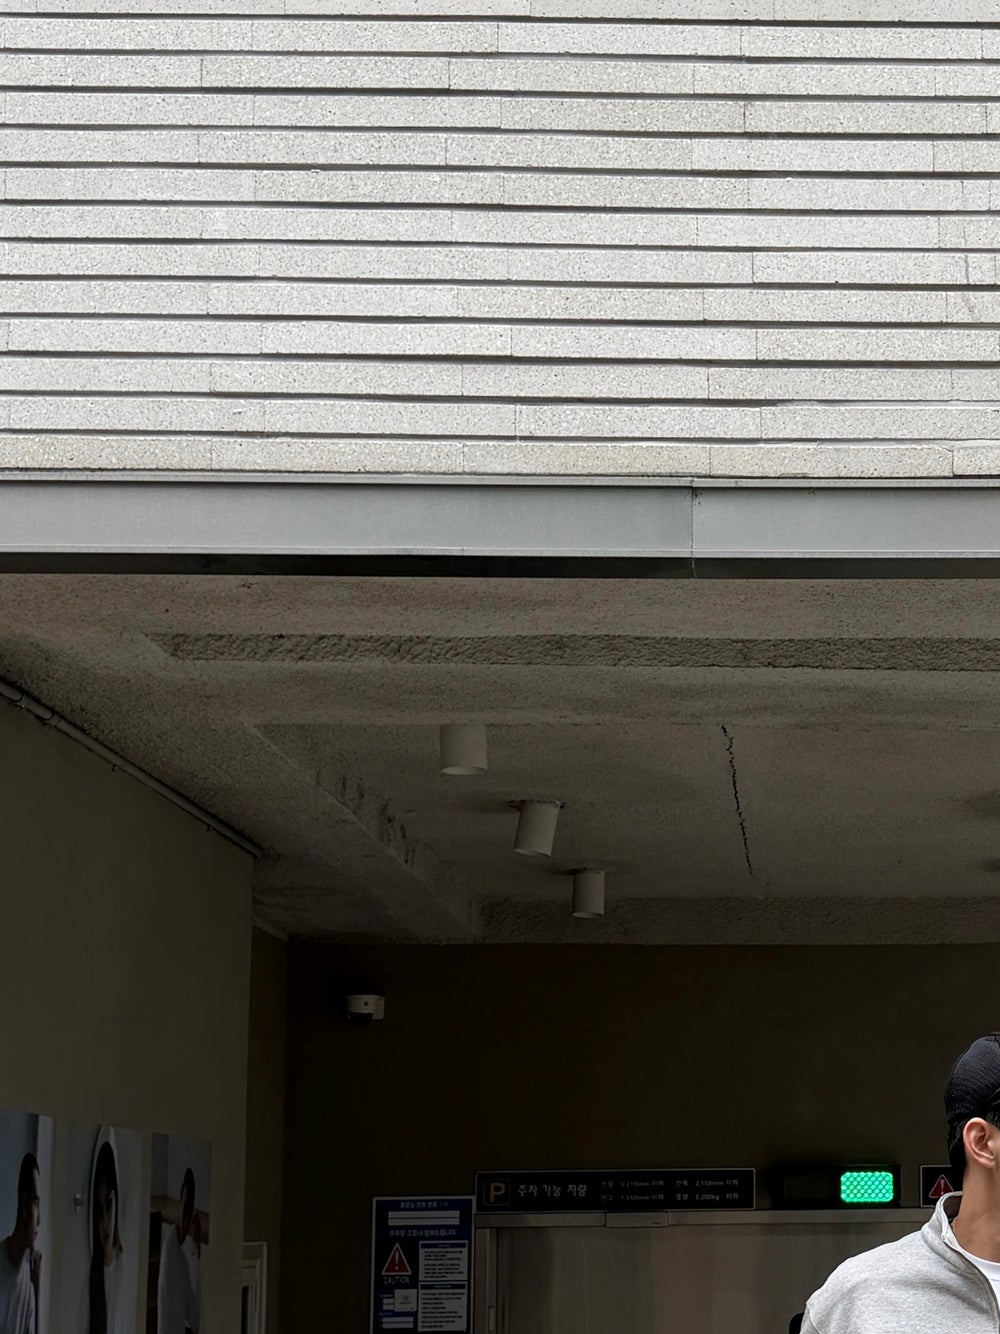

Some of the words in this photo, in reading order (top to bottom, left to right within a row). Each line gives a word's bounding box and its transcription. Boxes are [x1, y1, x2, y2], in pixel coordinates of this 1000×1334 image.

[489, 1182, 506, 1203] P
[518, 1184, 537, 1198] 주차
[542, 1184, 562, 1198] 가능
[567, 1184, 588, 1198] 차량
